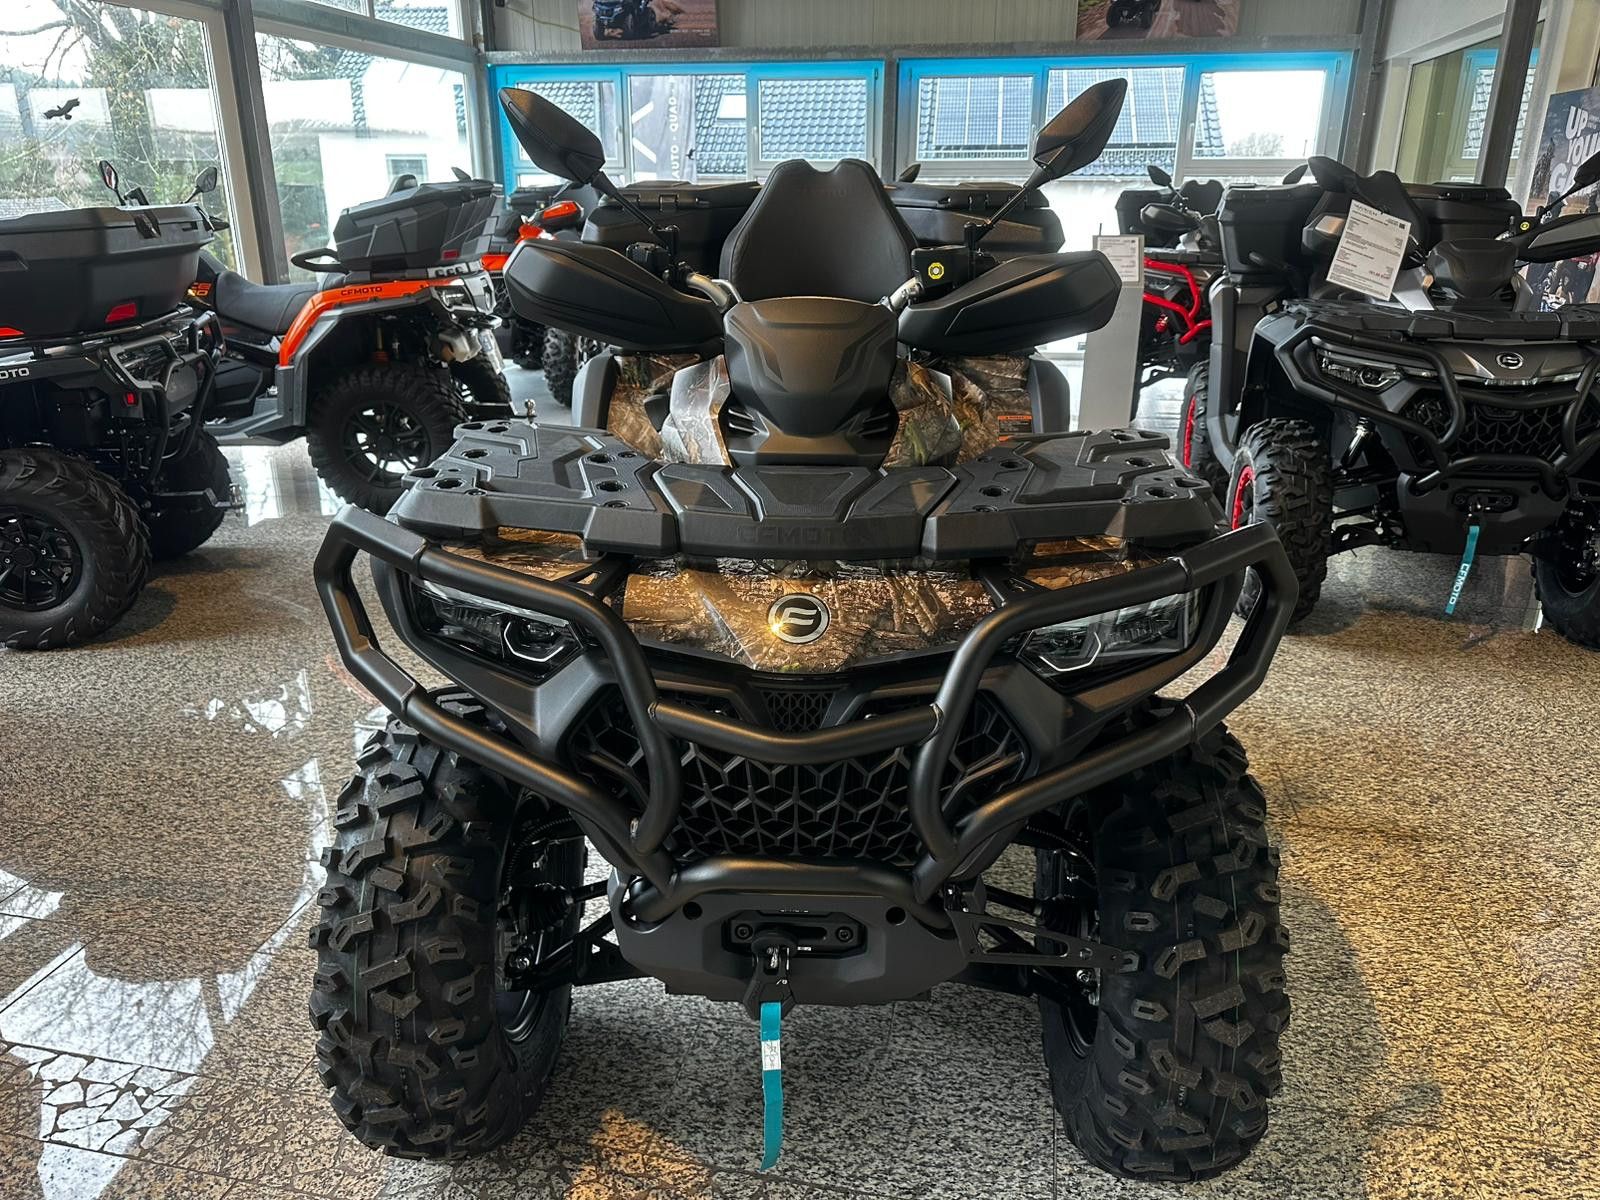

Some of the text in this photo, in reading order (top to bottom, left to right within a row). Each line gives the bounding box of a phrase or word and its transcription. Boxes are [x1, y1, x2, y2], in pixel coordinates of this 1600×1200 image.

[668, 96, 679, 133] QUAD
[1565, 105, 1589, 140] UP
[670, 145, 680, 180] AUTO
[340, 286, 383, 297] CFMOTO
[1448, 562, 1470, 605] CFMOTO
